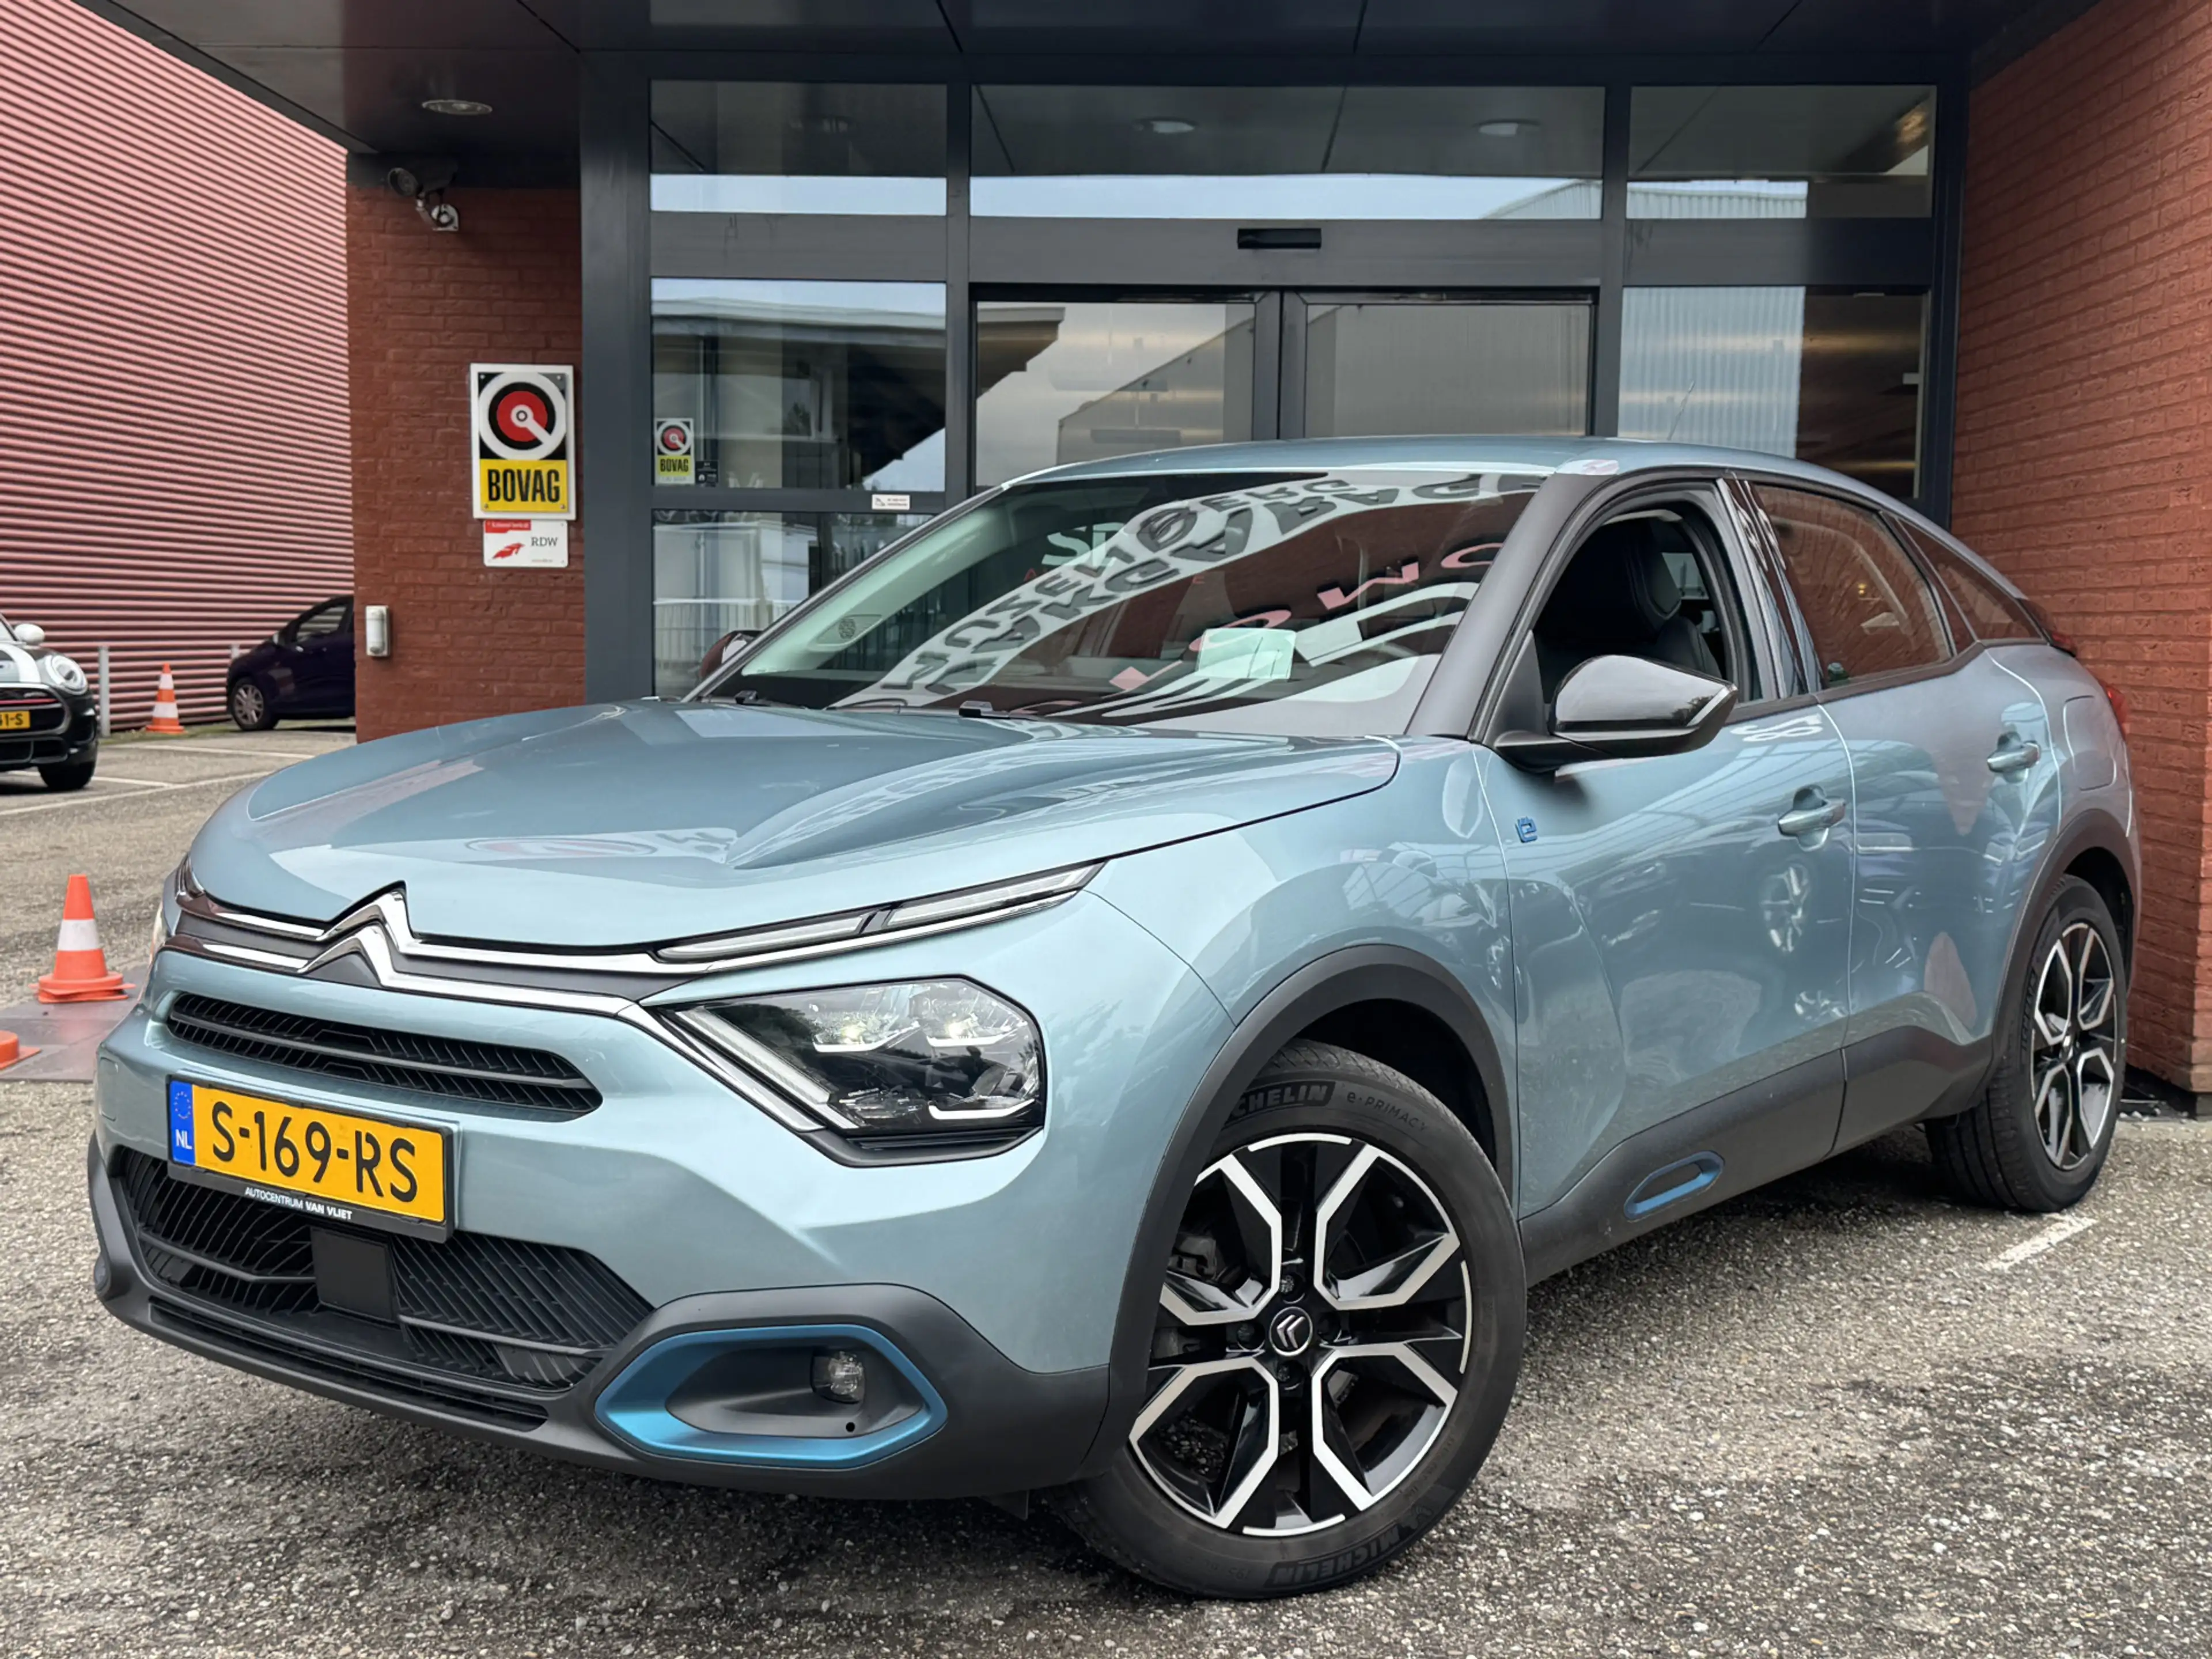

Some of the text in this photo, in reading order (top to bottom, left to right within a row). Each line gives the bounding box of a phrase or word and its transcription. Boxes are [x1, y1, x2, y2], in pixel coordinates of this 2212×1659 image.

[660, 459, 689, 472] BOVAG
[487, 468, 560, 503] BOVAG
[531, 537, 558, 547] RDW
[175, 1129, 193, 1150] NL
[212, 1101, 418, 1203] S-169-RS
[245, 1187, 353, 1220] AUTOCENTRUM VAN VLIET
